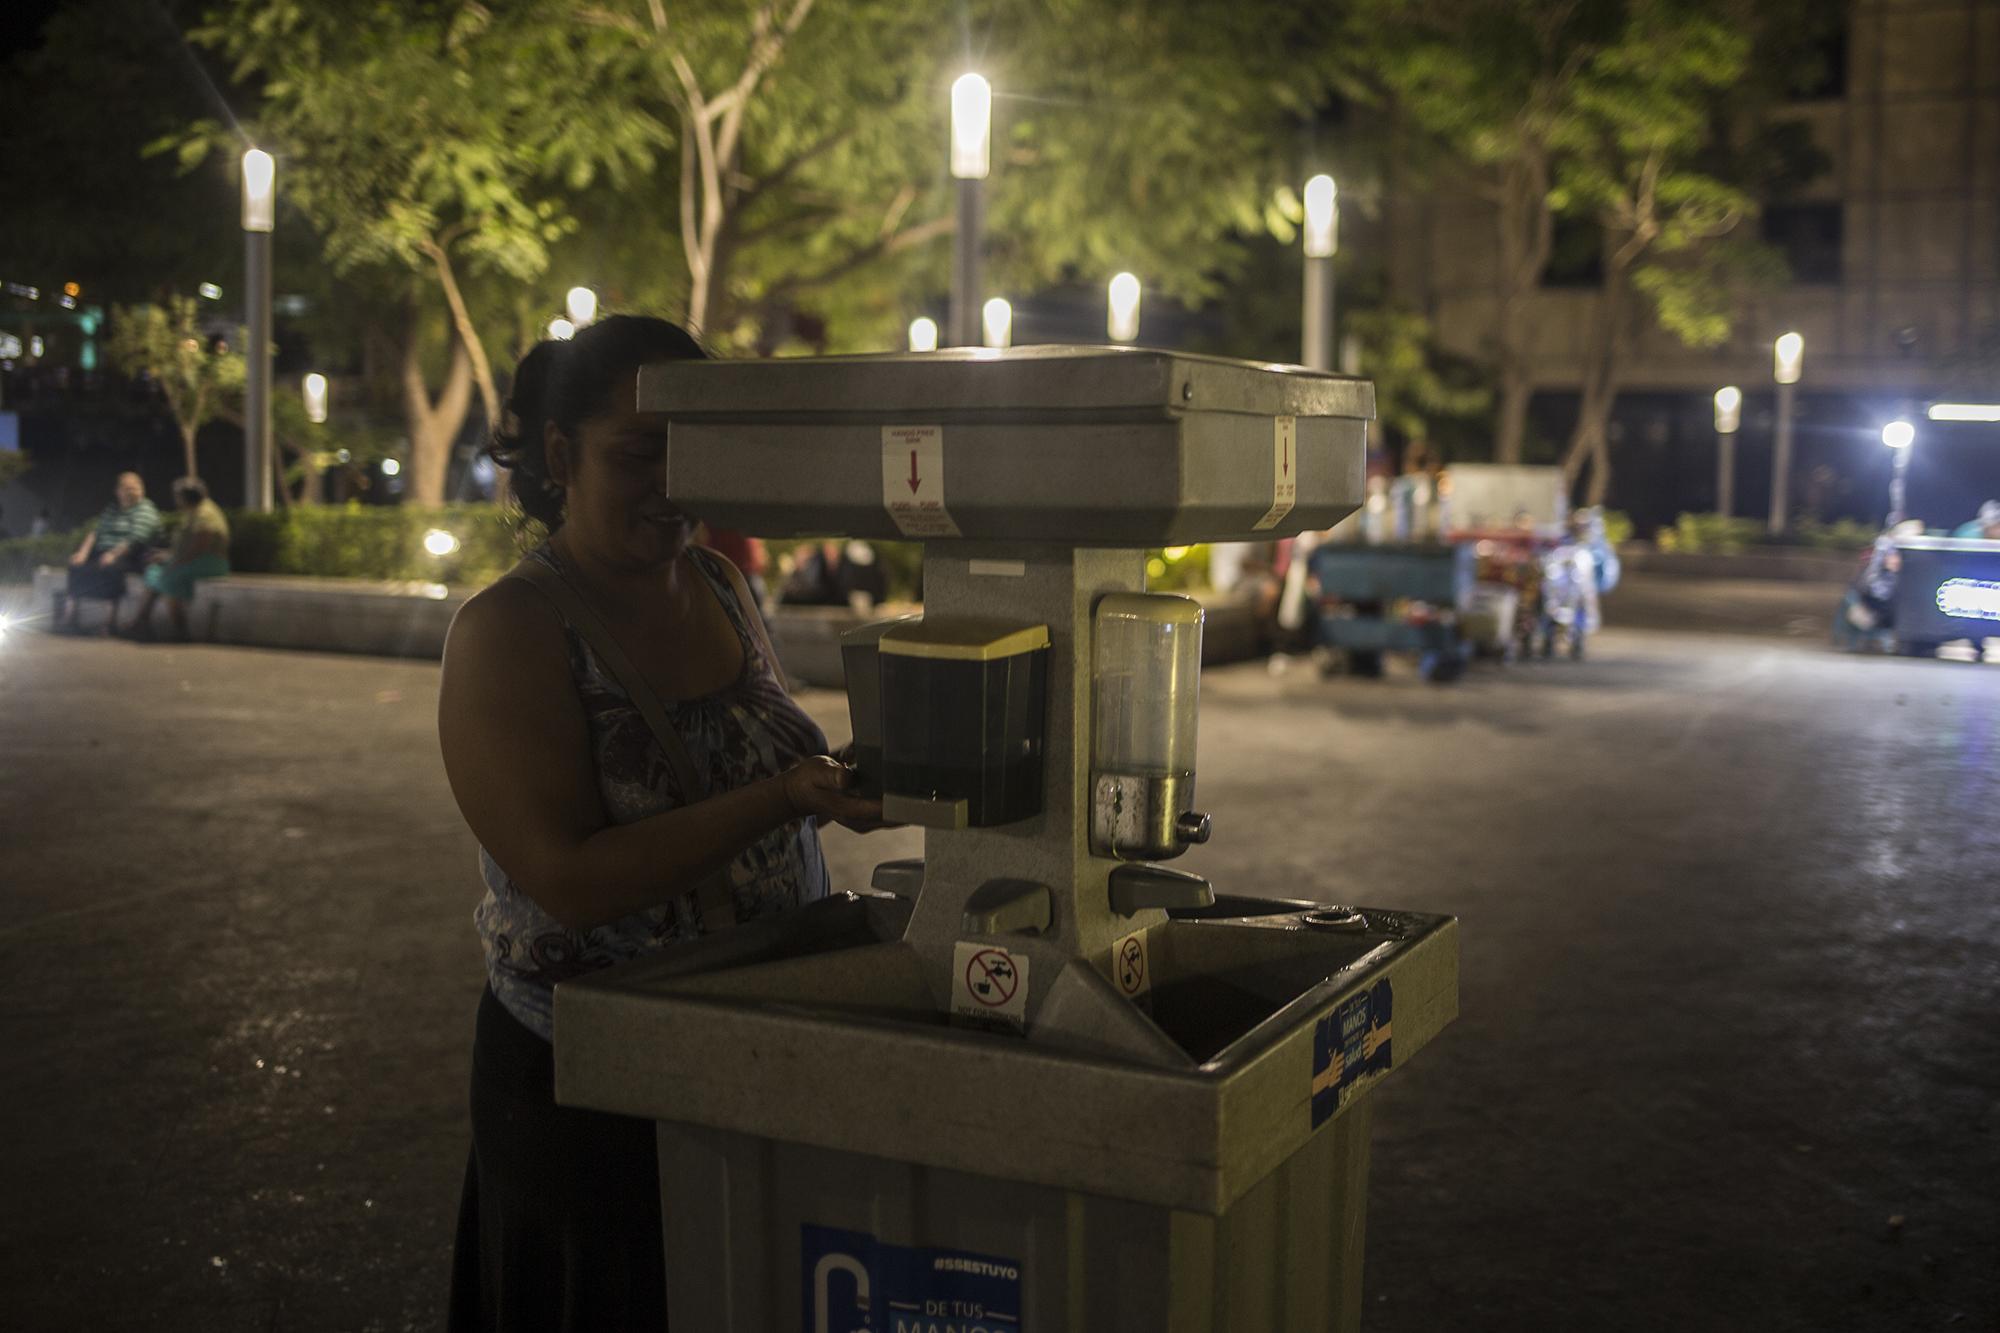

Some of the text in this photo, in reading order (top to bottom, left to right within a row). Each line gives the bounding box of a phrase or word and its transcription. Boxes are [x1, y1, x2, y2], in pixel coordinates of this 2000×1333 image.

[934, 1257, 1018, 1280] #SSESTUYO
[926, 1300, 983, 1320] DE TUS
